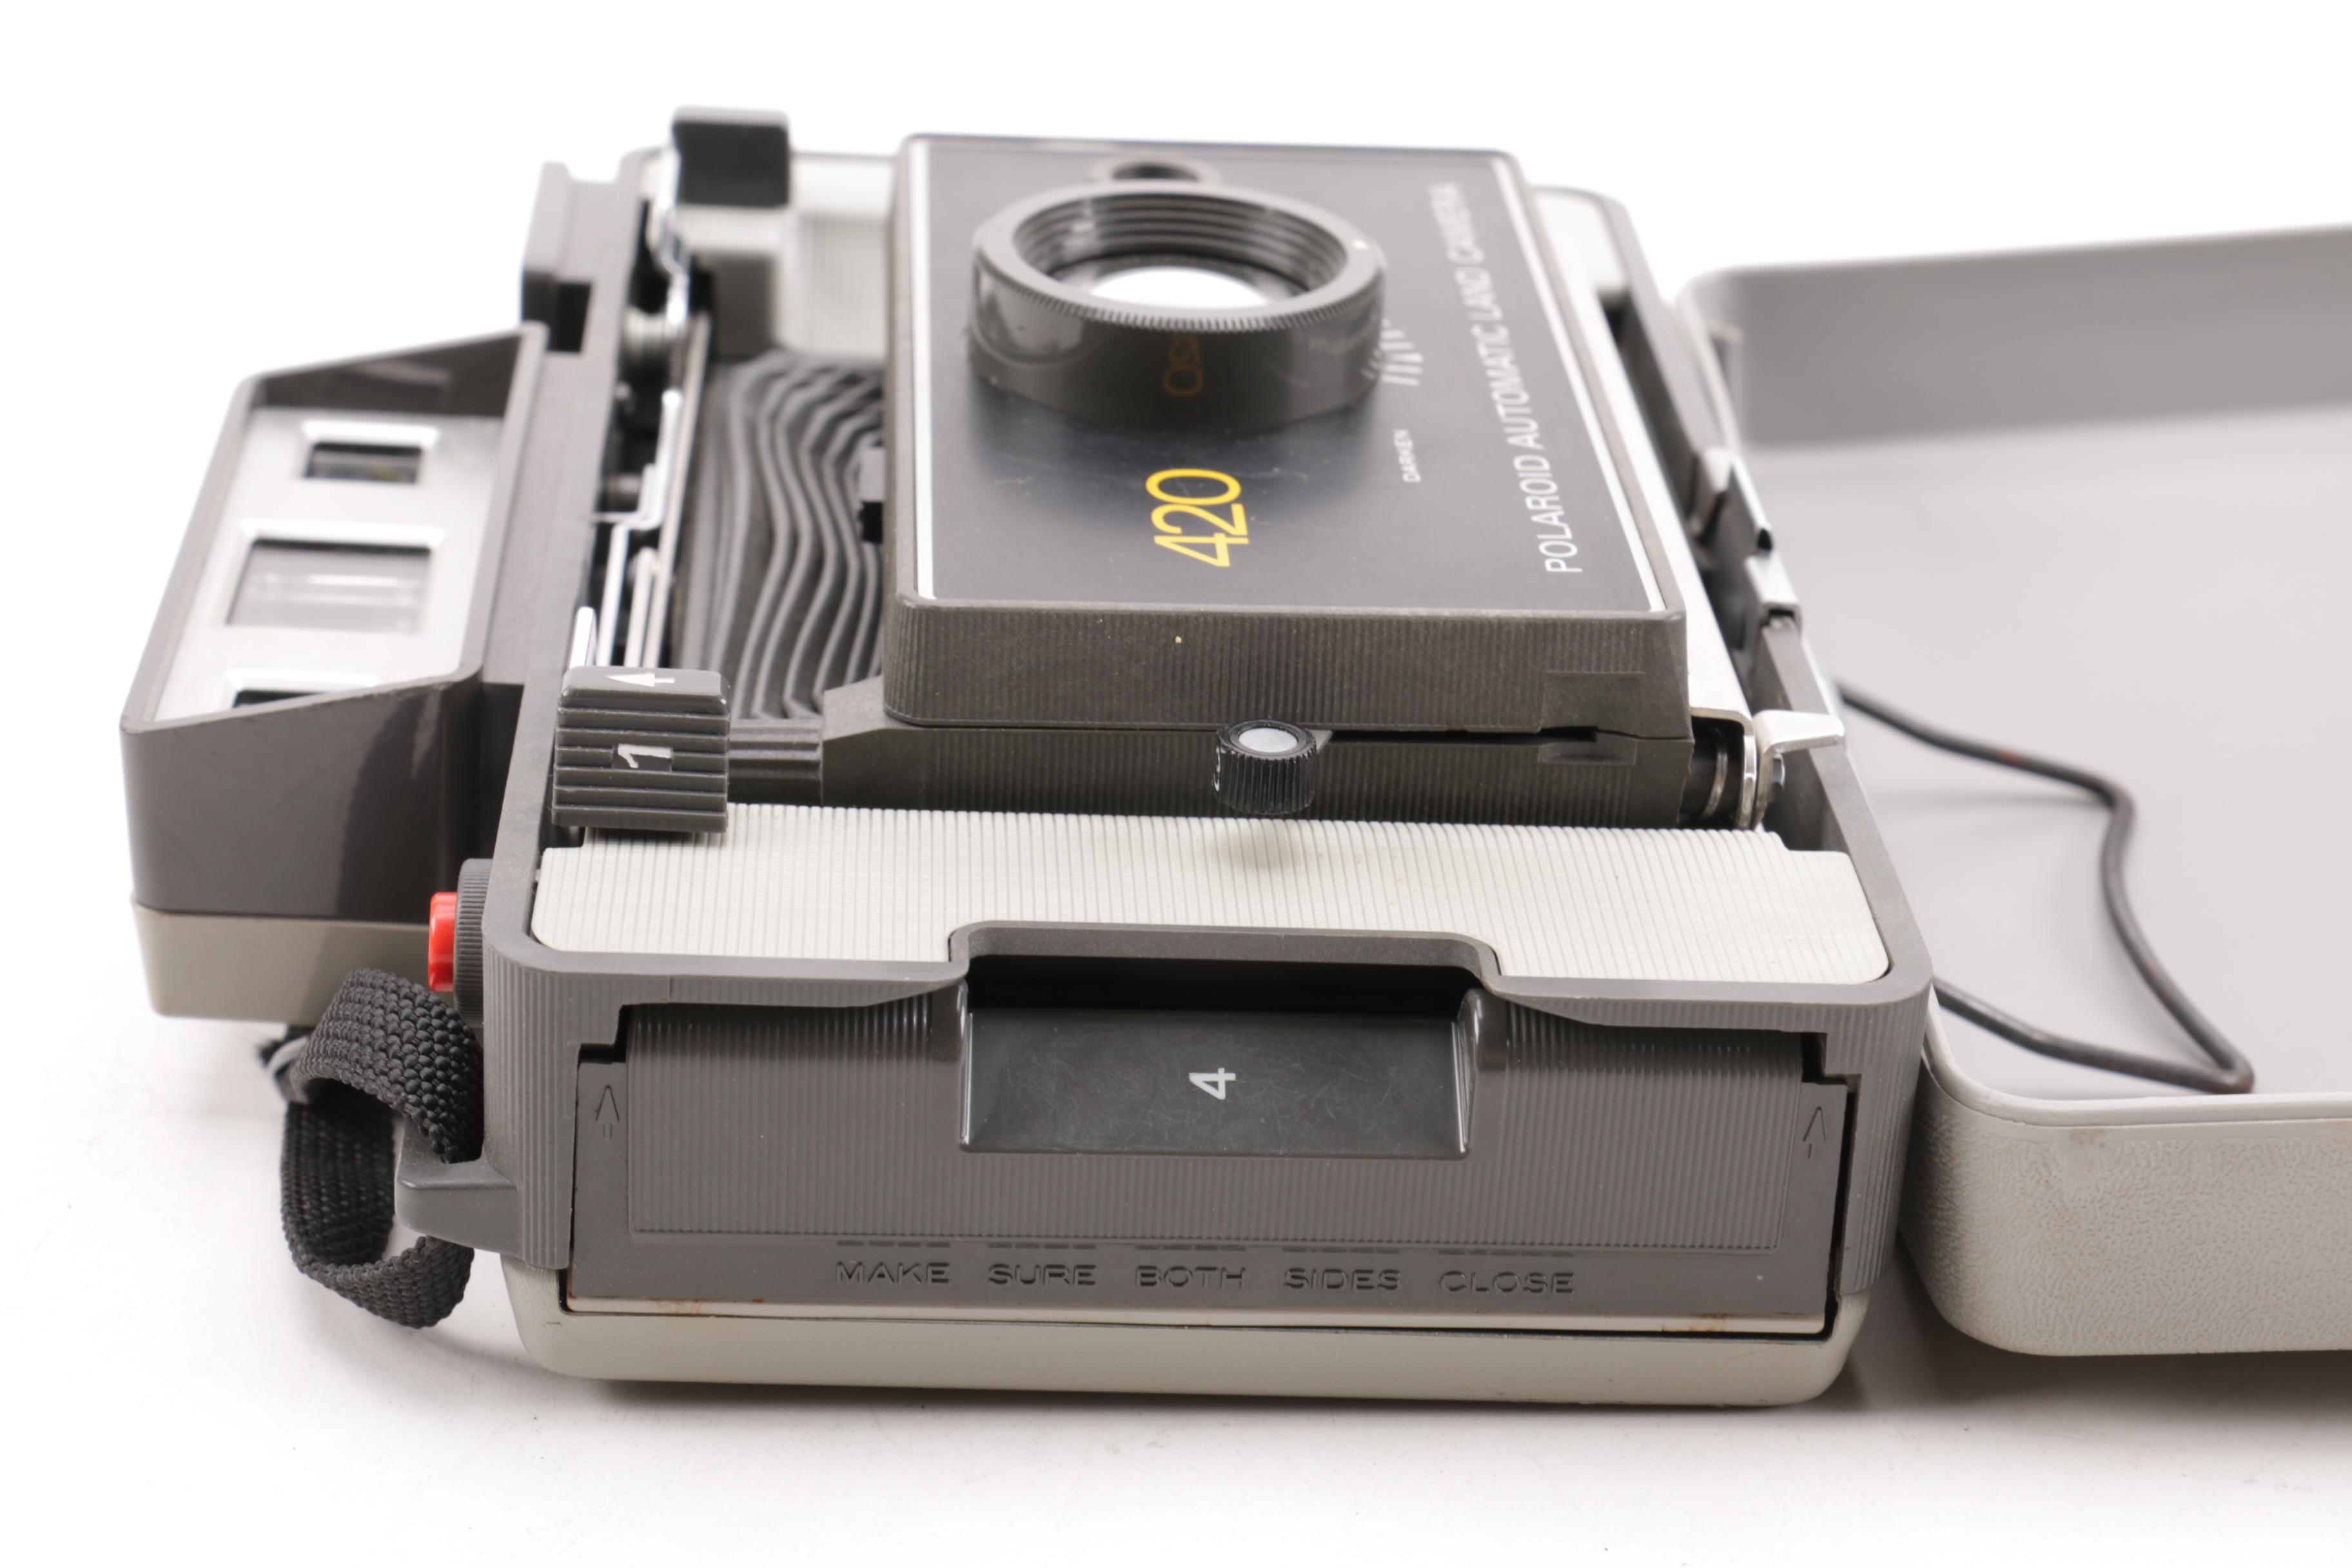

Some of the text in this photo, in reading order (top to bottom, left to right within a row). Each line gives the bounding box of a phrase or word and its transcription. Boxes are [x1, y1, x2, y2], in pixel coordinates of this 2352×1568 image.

[1455, 266, 1503, 320] LAND
[1471, 324, 1544, 450] AUTOMATIC
[1393, 429, 1421, 483] DARKEN
[1146, 468, 1249, 567] 420
[1513, 455, 1583, 573] POLAROID
[617, 743, 672, 769] 1
[1189, 1067, 1236, 1100] 4
[836, 1262, 1575, 1293] MAKE SURE BOTH SIDES CLOSE
